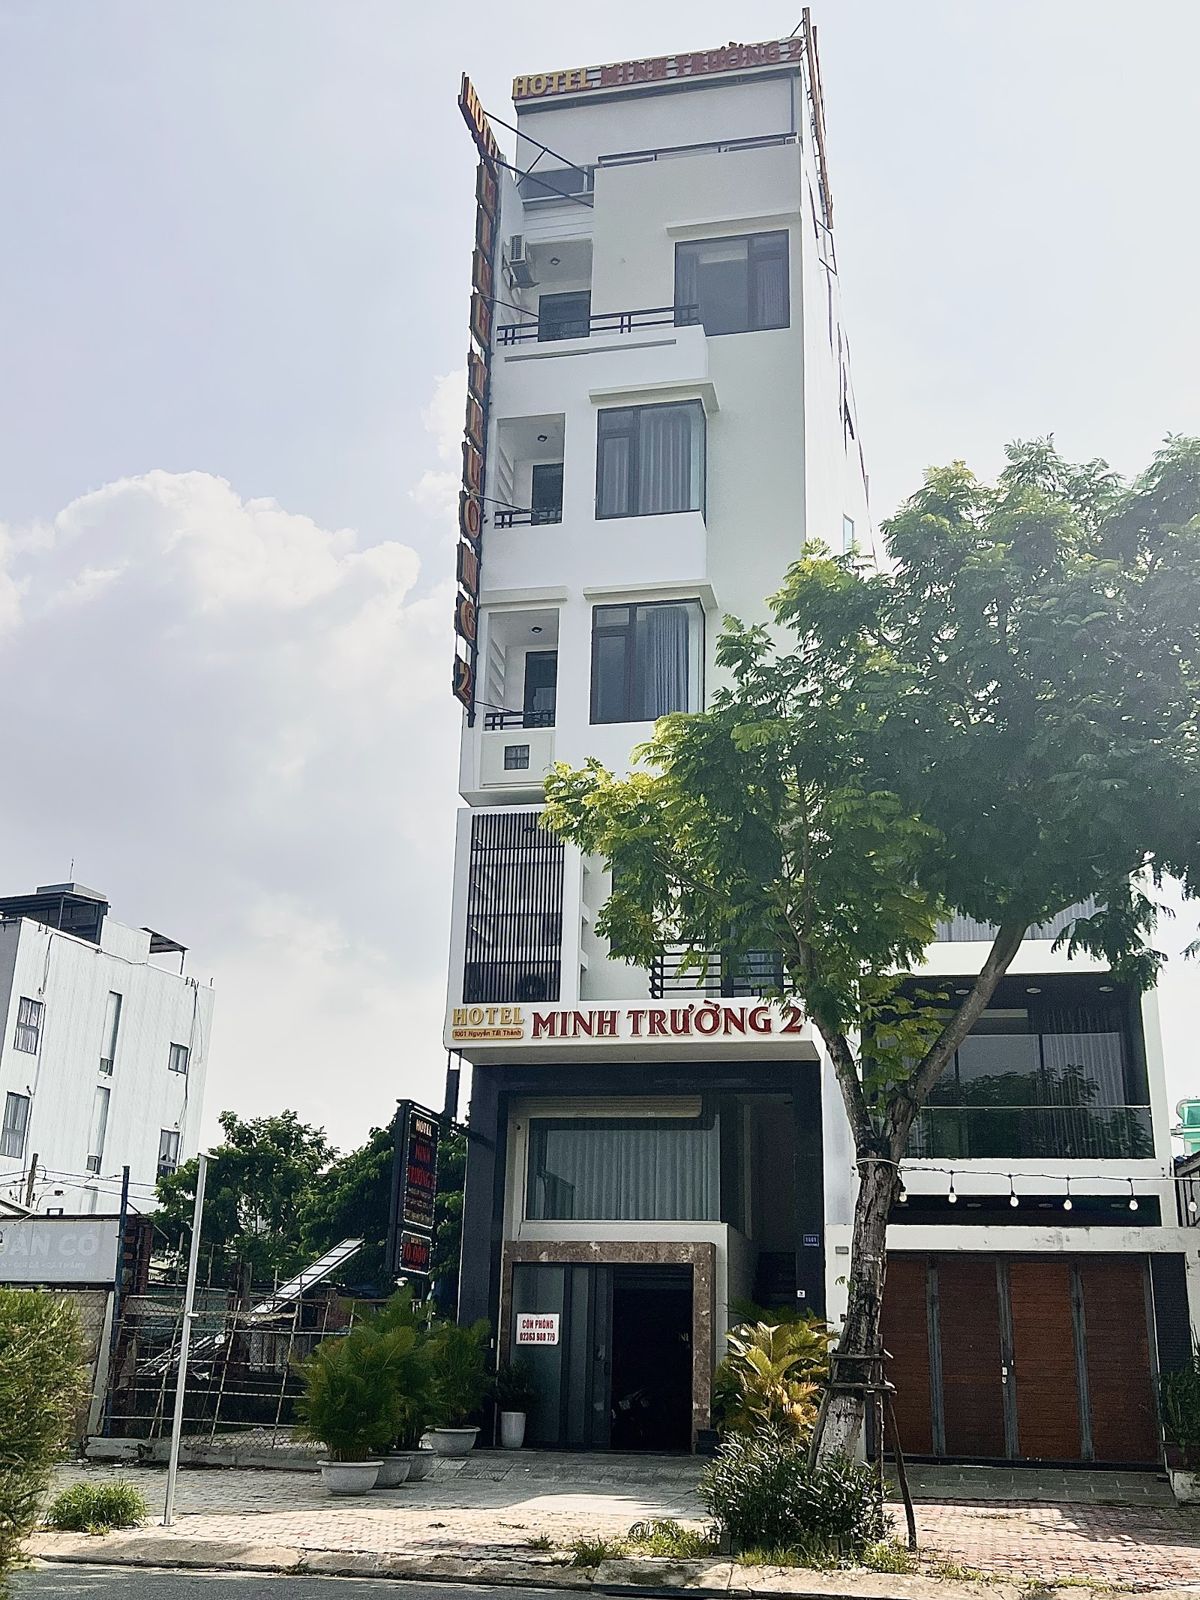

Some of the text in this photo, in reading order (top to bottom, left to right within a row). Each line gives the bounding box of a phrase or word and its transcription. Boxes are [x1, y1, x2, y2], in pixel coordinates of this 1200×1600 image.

[513, 37, 803, 97] HOTEL MINH TRƯỜNG 2
[455, 660, 474, 705] 2
[452, 1006, 526, 1026] HOTEL
[531, 999, 803, 1038] MINH TRƯỜNG 2
[415, 1118, 433, 1138] HOTEL
